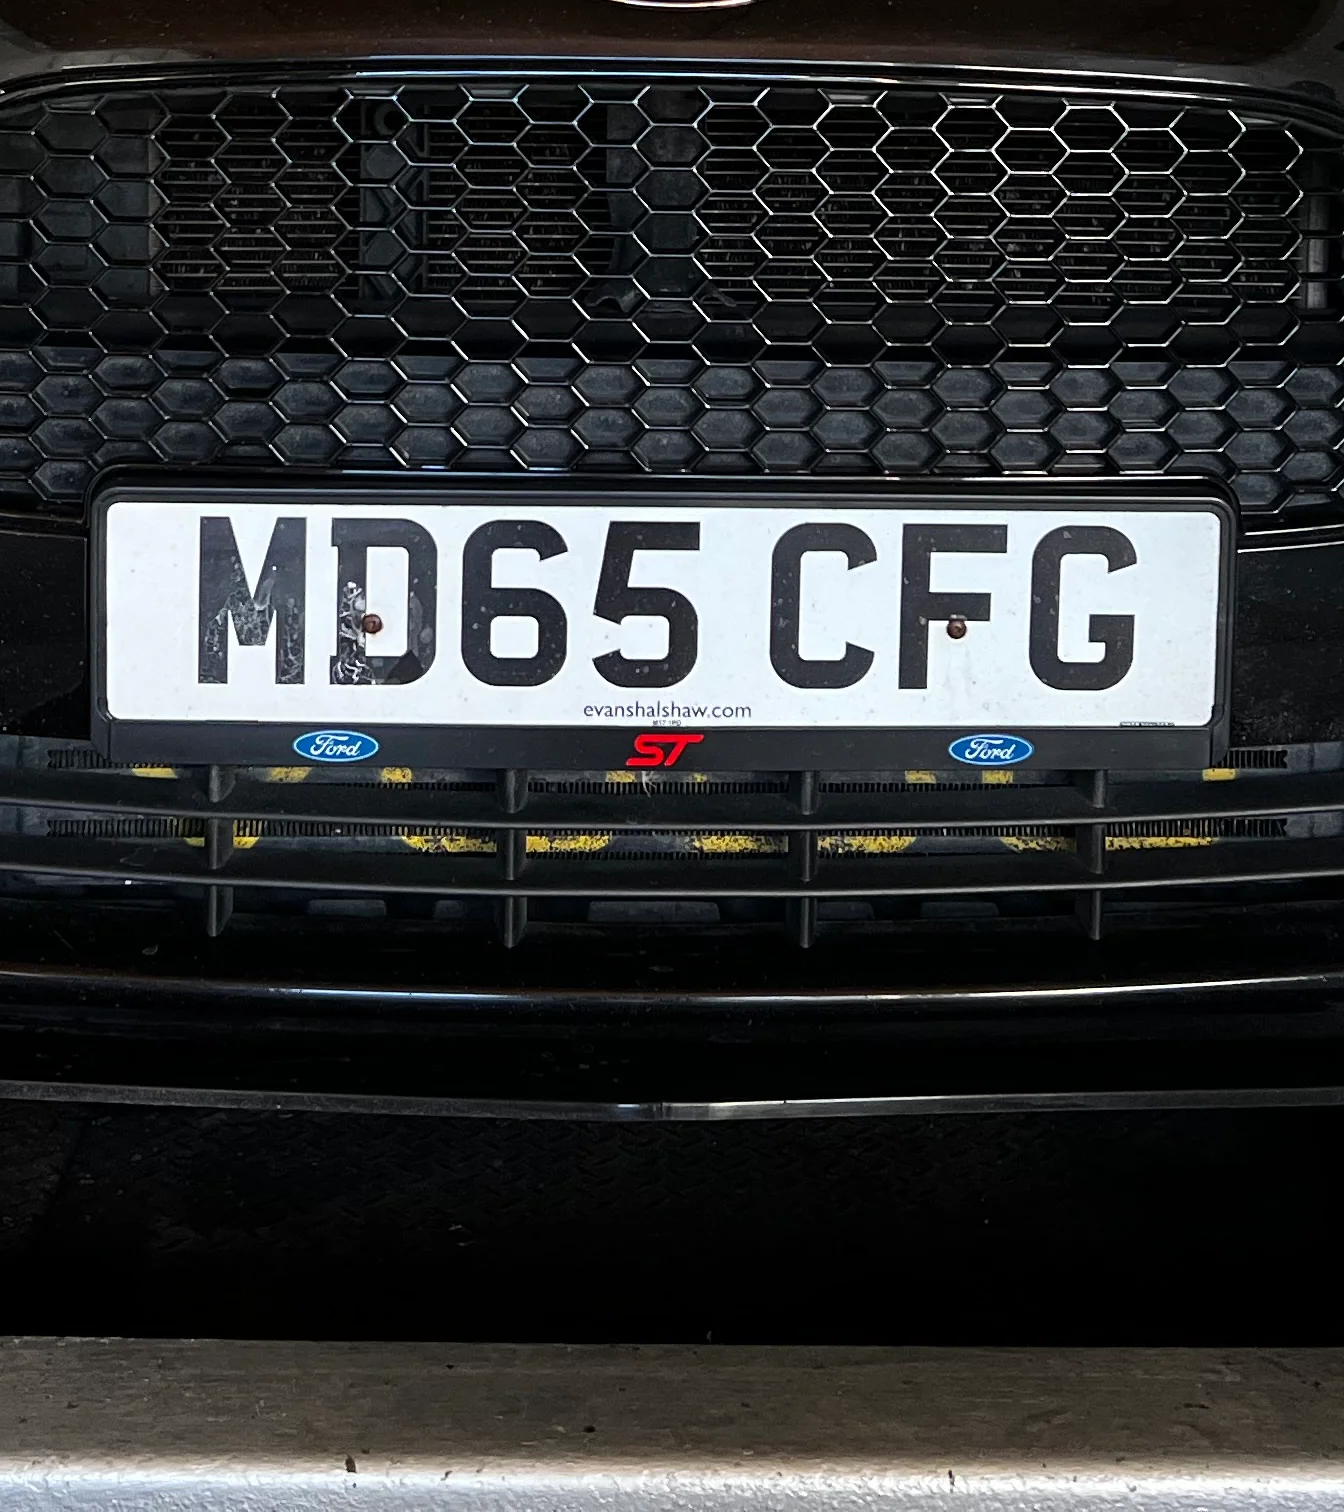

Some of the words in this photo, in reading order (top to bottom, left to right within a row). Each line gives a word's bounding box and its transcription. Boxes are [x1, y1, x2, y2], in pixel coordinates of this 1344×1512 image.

[198, 516, 700, 689] MD65
[770, 522, 1138, 691] CFG
[583, 701, 752, 718] evanshalshaw.com
[309, 734, 362, 756] Ford
[625, 734, 704, 767] ST
[964, 738, 1016, 760] Ford
